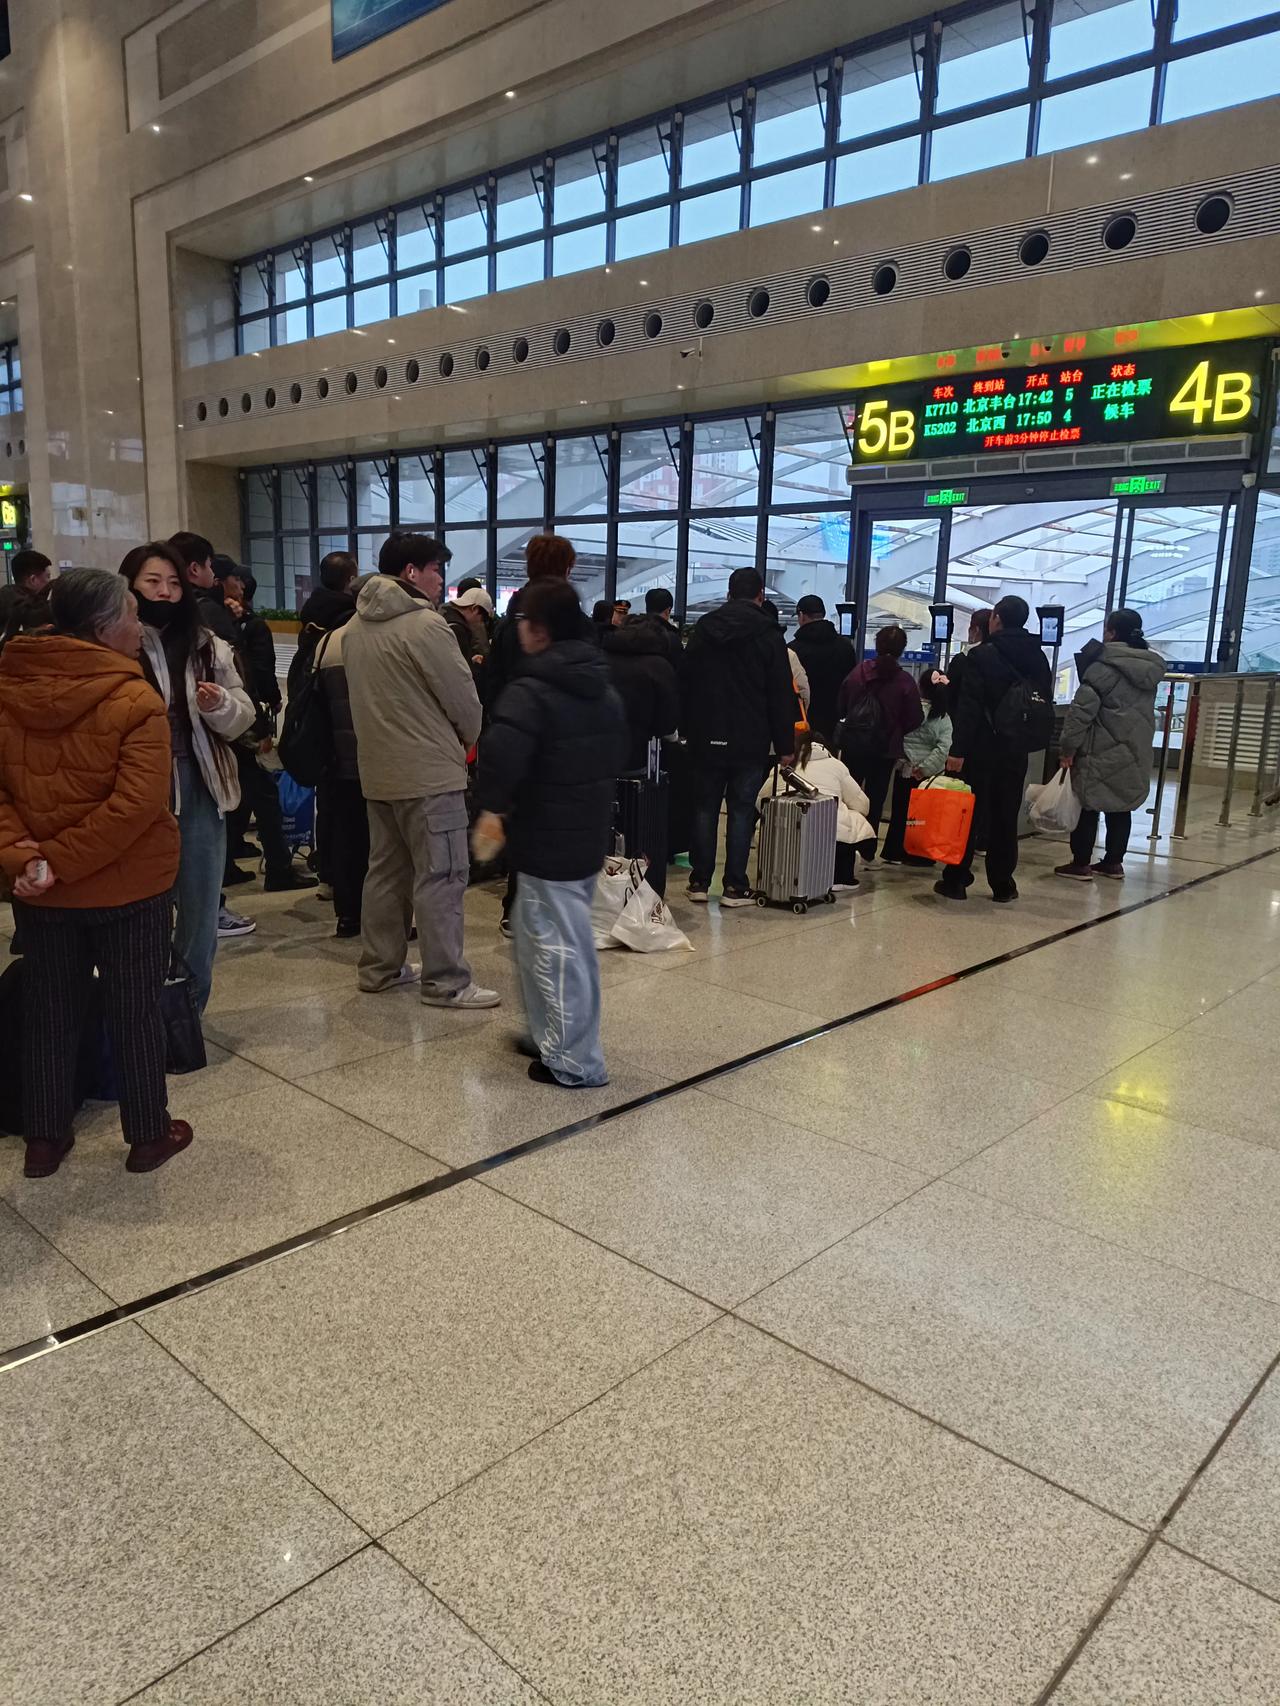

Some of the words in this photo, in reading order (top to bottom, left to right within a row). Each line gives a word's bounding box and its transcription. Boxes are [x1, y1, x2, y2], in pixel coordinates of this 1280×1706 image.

[925, 401, 959, 417] K7710
[963, 393, 1017, 414] 北京丰台
[1018, 390, 1054, 406] 17:42
[1065, 387, 1075, 401] 5
[1091, 378, 1153, 400] 正在检票
[933, 386, 954, 399] 车次
[973, 378, 1006, 394] 终到站
[1026, 374, 1049, 388] 开点
[1060, 369, 1083, 383] 站台
[1110, 363, 1136, 379] 状态
[1169, 360, 1252, 424] 4B
[858, 400, 915, 454] 5B
[923, 421, 957, 437] K5202
[966, 415, 1007, 433] 北京西
[1016, 411, 1053, 427] 17:50
[1063, 409, 1073, 423] 4
[1104, 402, 1135, 421] 候车
[984, 427, 1082, 448] 开车前3分钟停止检票
[1145, 480, 1162, 490] EXIT
